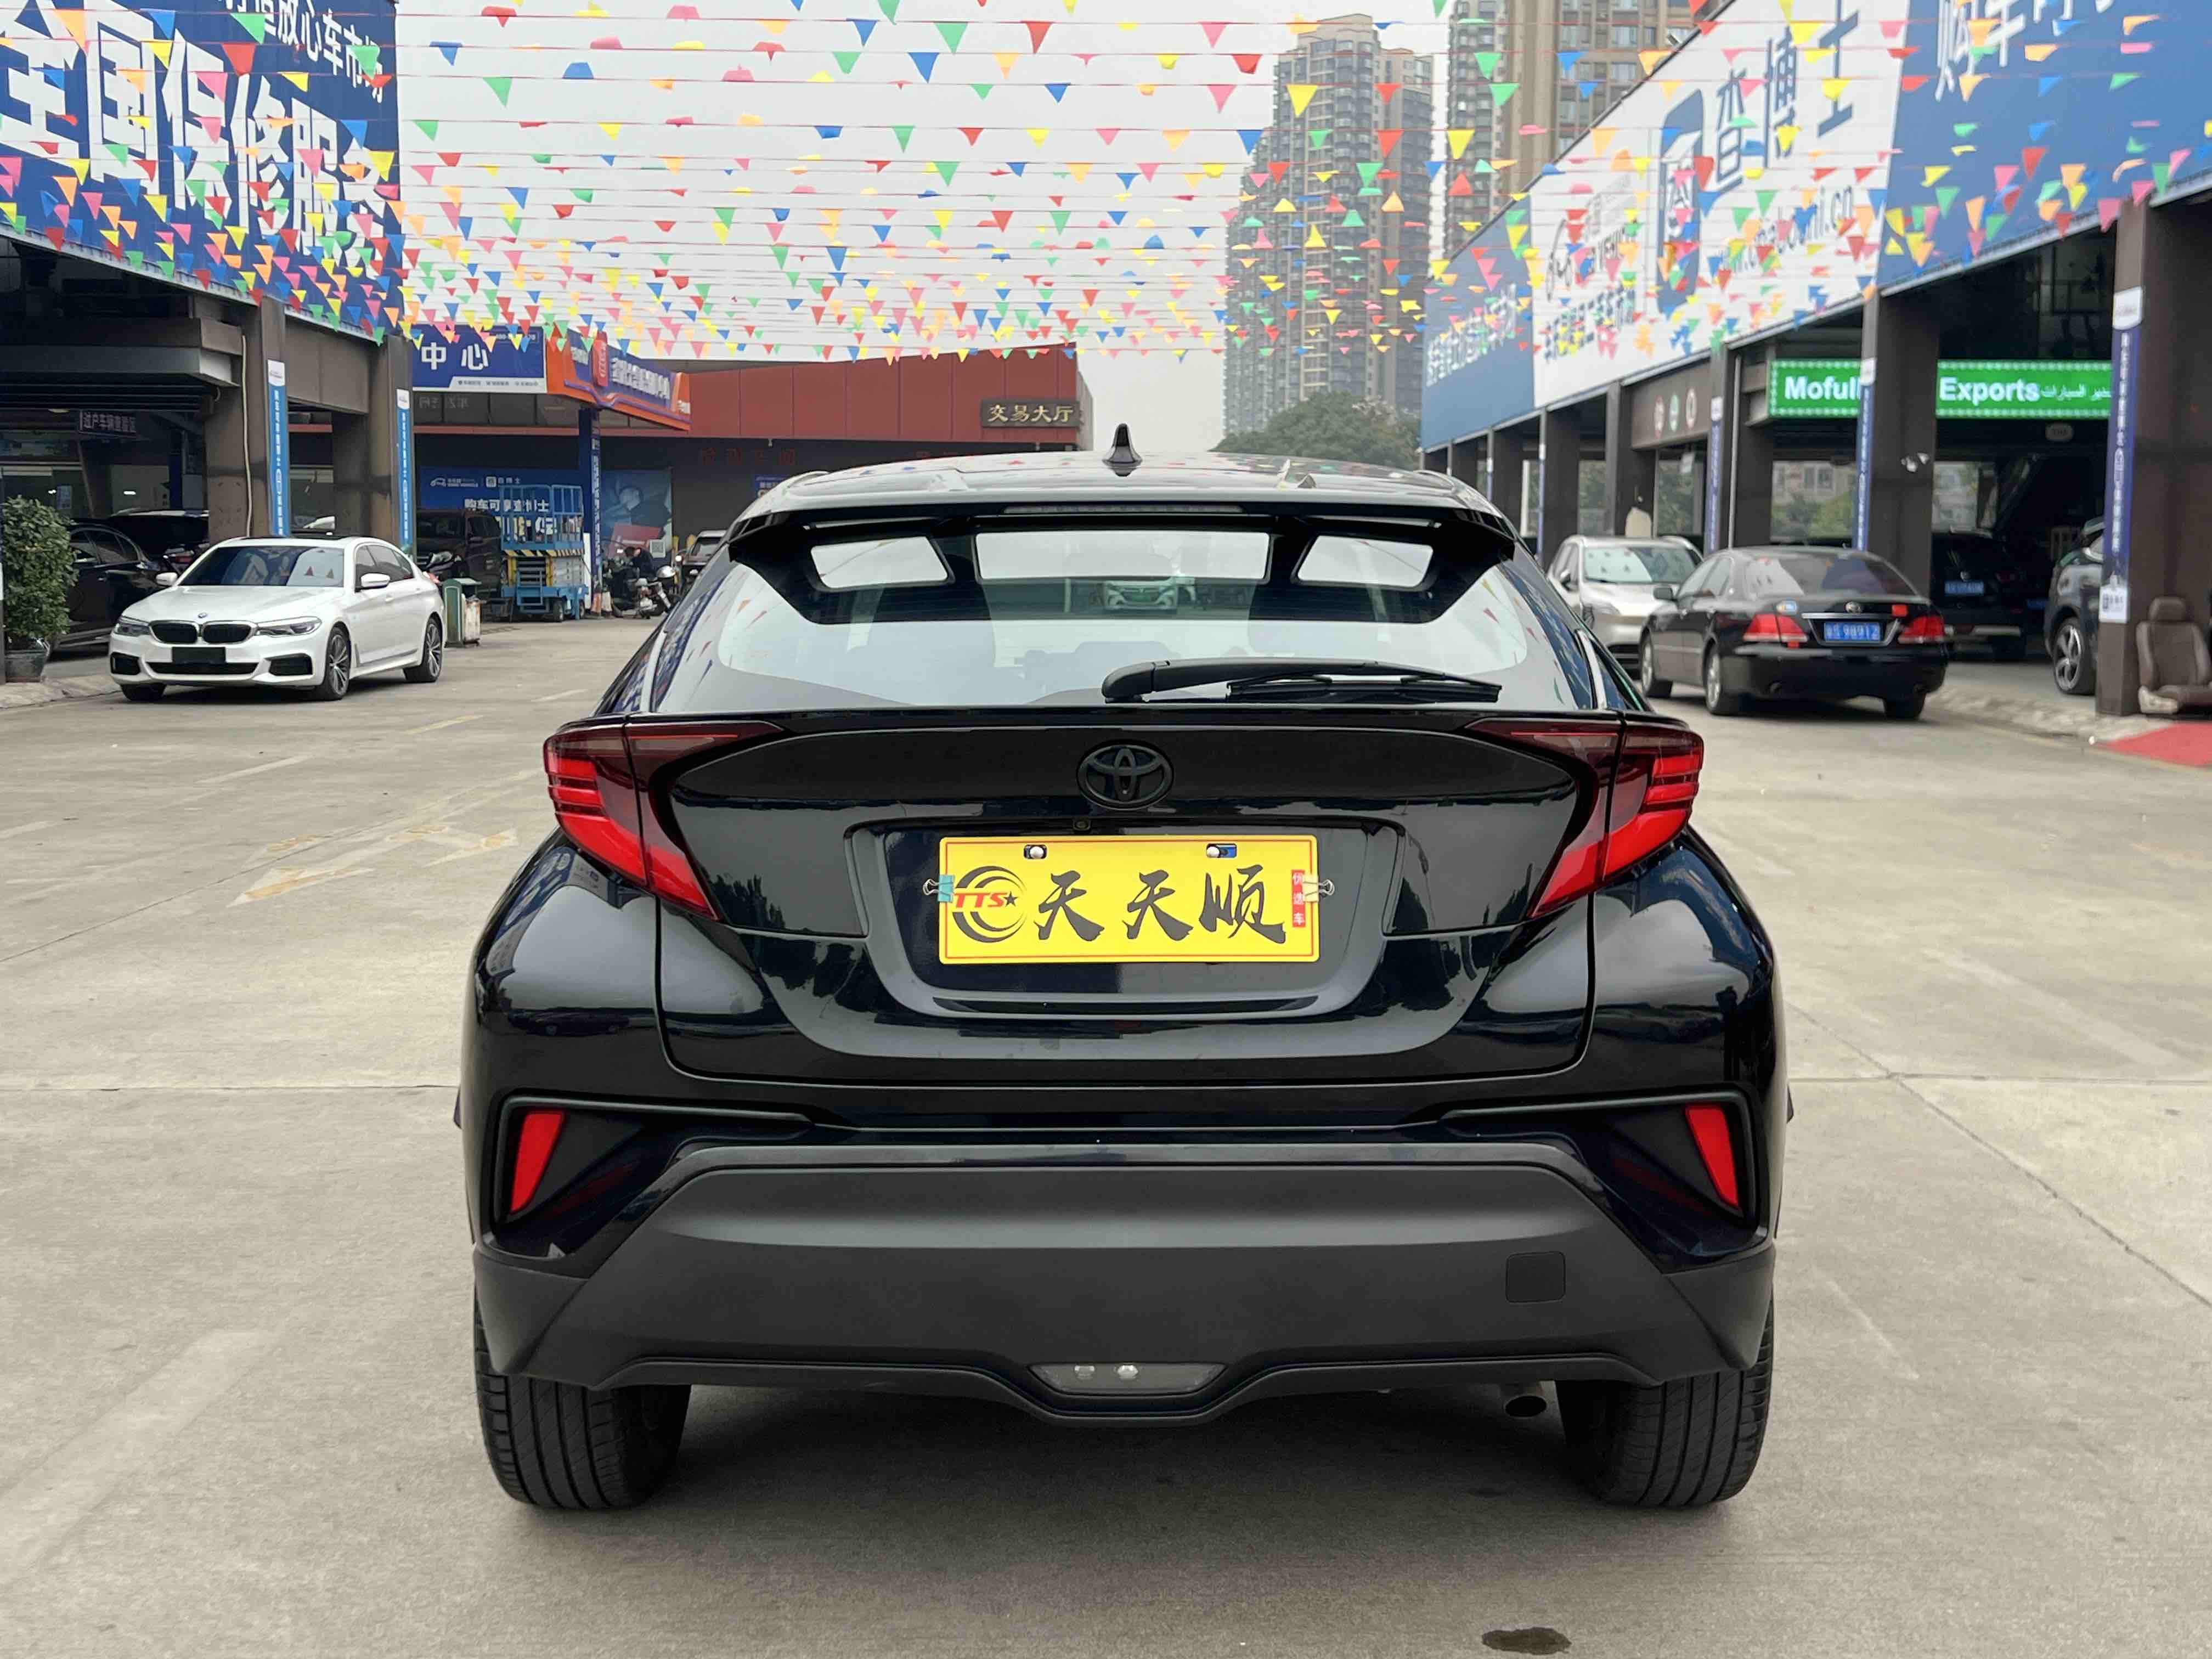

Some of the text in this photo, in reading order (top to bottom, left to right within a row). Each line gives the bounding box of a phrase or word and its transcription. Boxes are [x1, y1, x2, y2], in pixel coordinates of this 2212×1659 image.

[421, 342, 489, 370] 中心
[1939, 376, 2040, 406] Exports
[988, 404, 1074, 422] 交易大厅
[953, 892, 1008, 908] TTS
[1034, 865, 1286, 944] 天天顺
